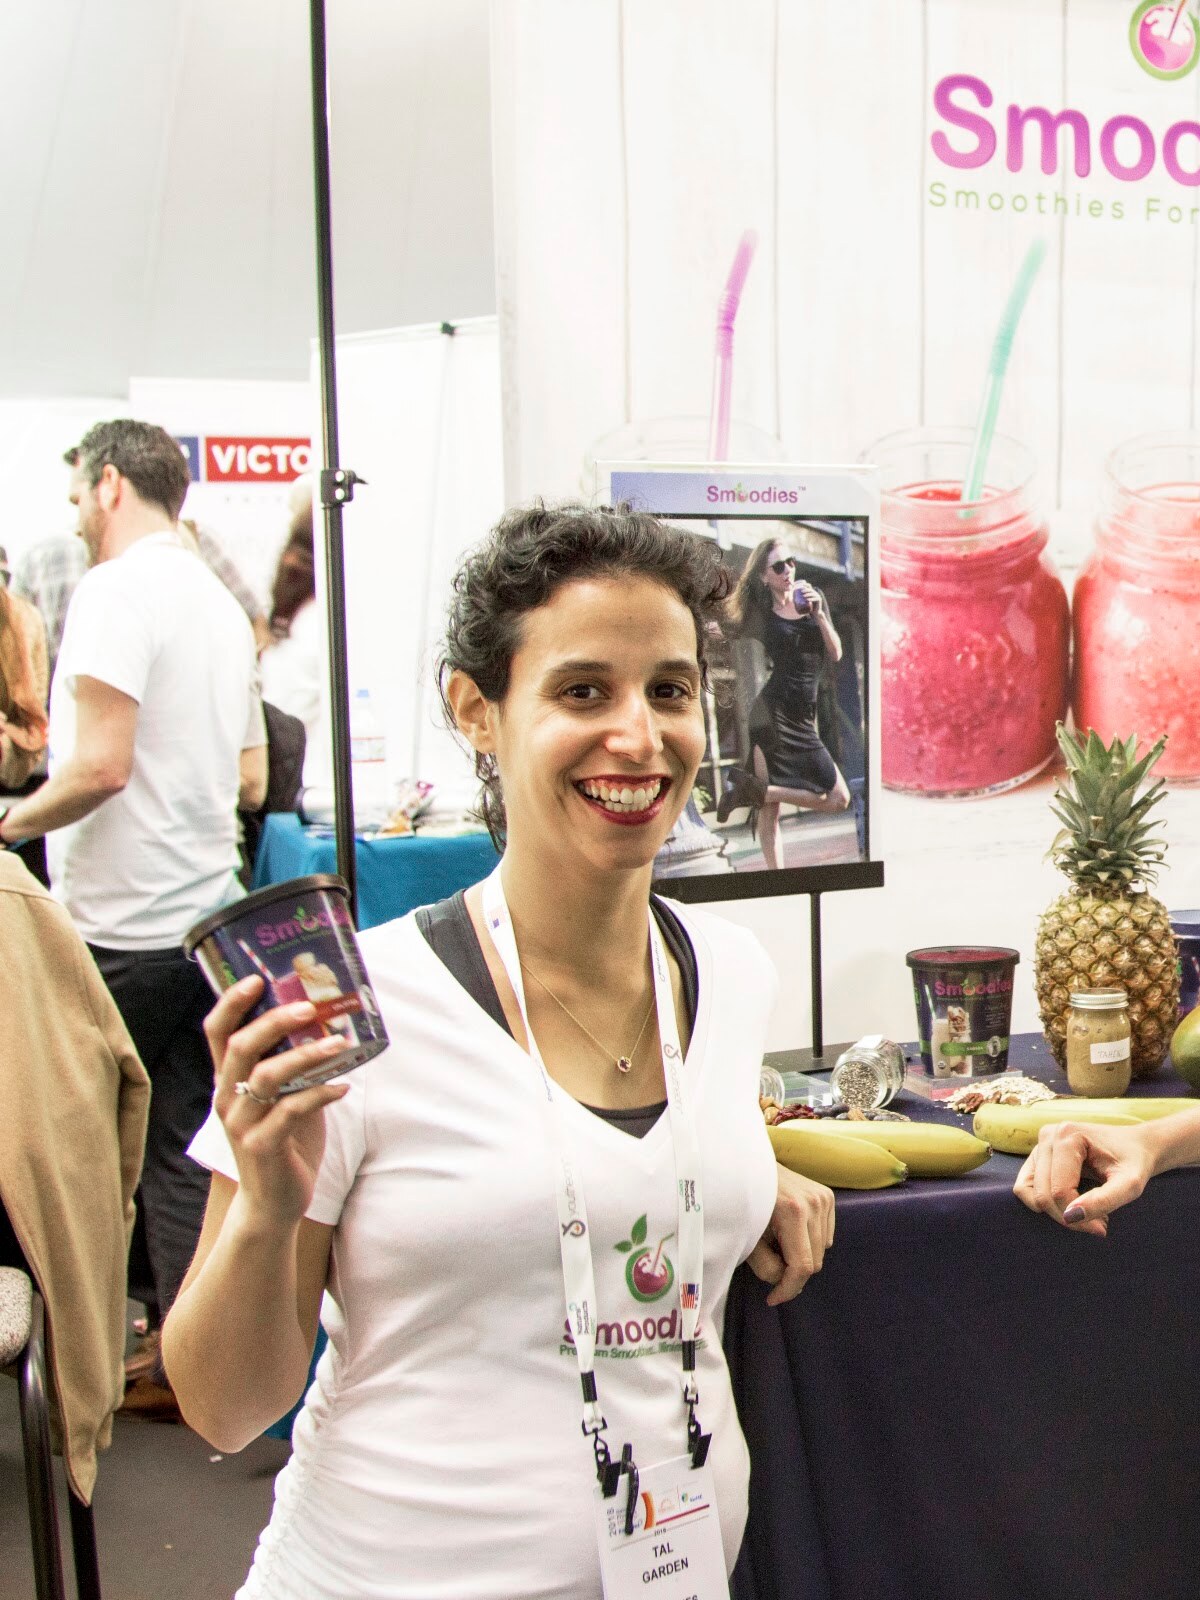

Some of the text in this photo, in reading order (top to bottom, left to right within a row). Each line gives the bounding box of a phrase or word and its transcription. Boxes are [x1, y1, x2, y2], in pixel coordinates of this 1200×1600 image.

[928, 182, 1126, 221] Smoothies
[1146, 198, 1200, 225] For
[706, 484, 798, 504] Smoodies
[652, 1542, 674, 1558] TAL
[642, 1557, 689, 1584] GARDEN
